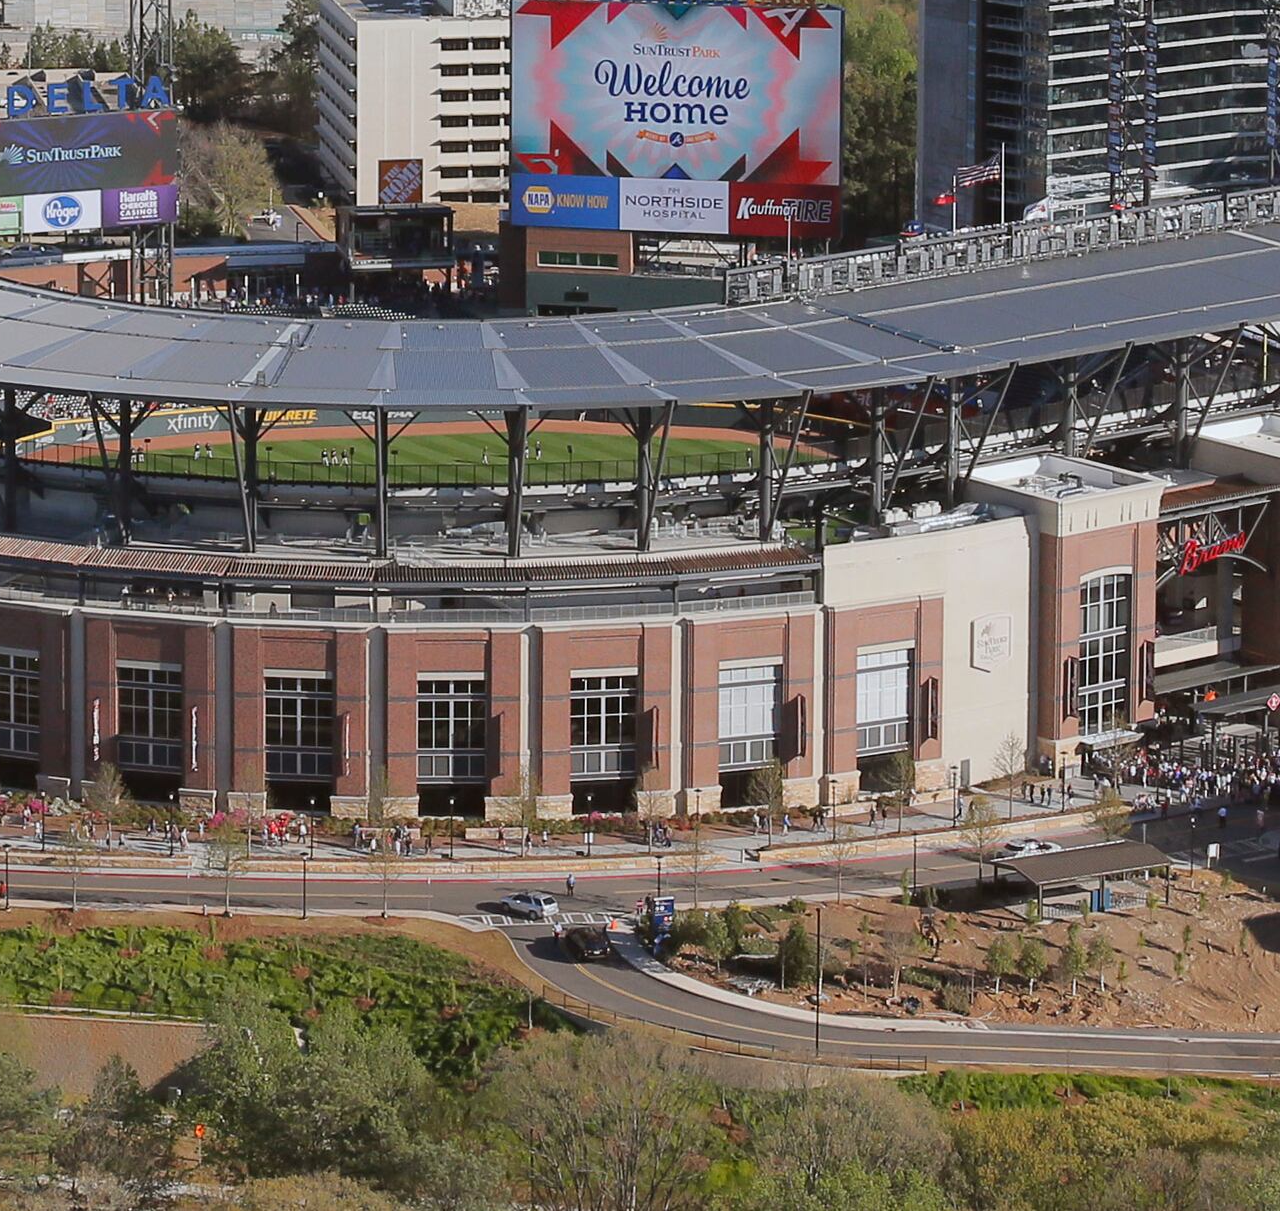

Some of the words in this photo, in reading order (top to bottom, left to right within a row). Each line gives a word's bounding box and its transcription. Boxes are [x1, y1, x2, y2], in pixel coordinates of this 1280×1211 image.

[594, 59, 750, 100] Welcome
[6, 75, 172, 116] DELTA
[380, 161, 421, 203] HOME
[46, 199, 80, 225] Kroger
[119, 208, 158, 217] CASINOS
[527, 193, 550, 206] NAPA
[556, 193, 585, 208] KNOW
[587, 195, 609, 209] HOW
[625, 195, 724, 210] NORTHSIDE
[736, 197, 798, 220] Kauffman
[782, 198, 833, 223] TIRE
[642, 209, 706, 220] HOSPITAL
[167, 412, 220, 434] xfinity
